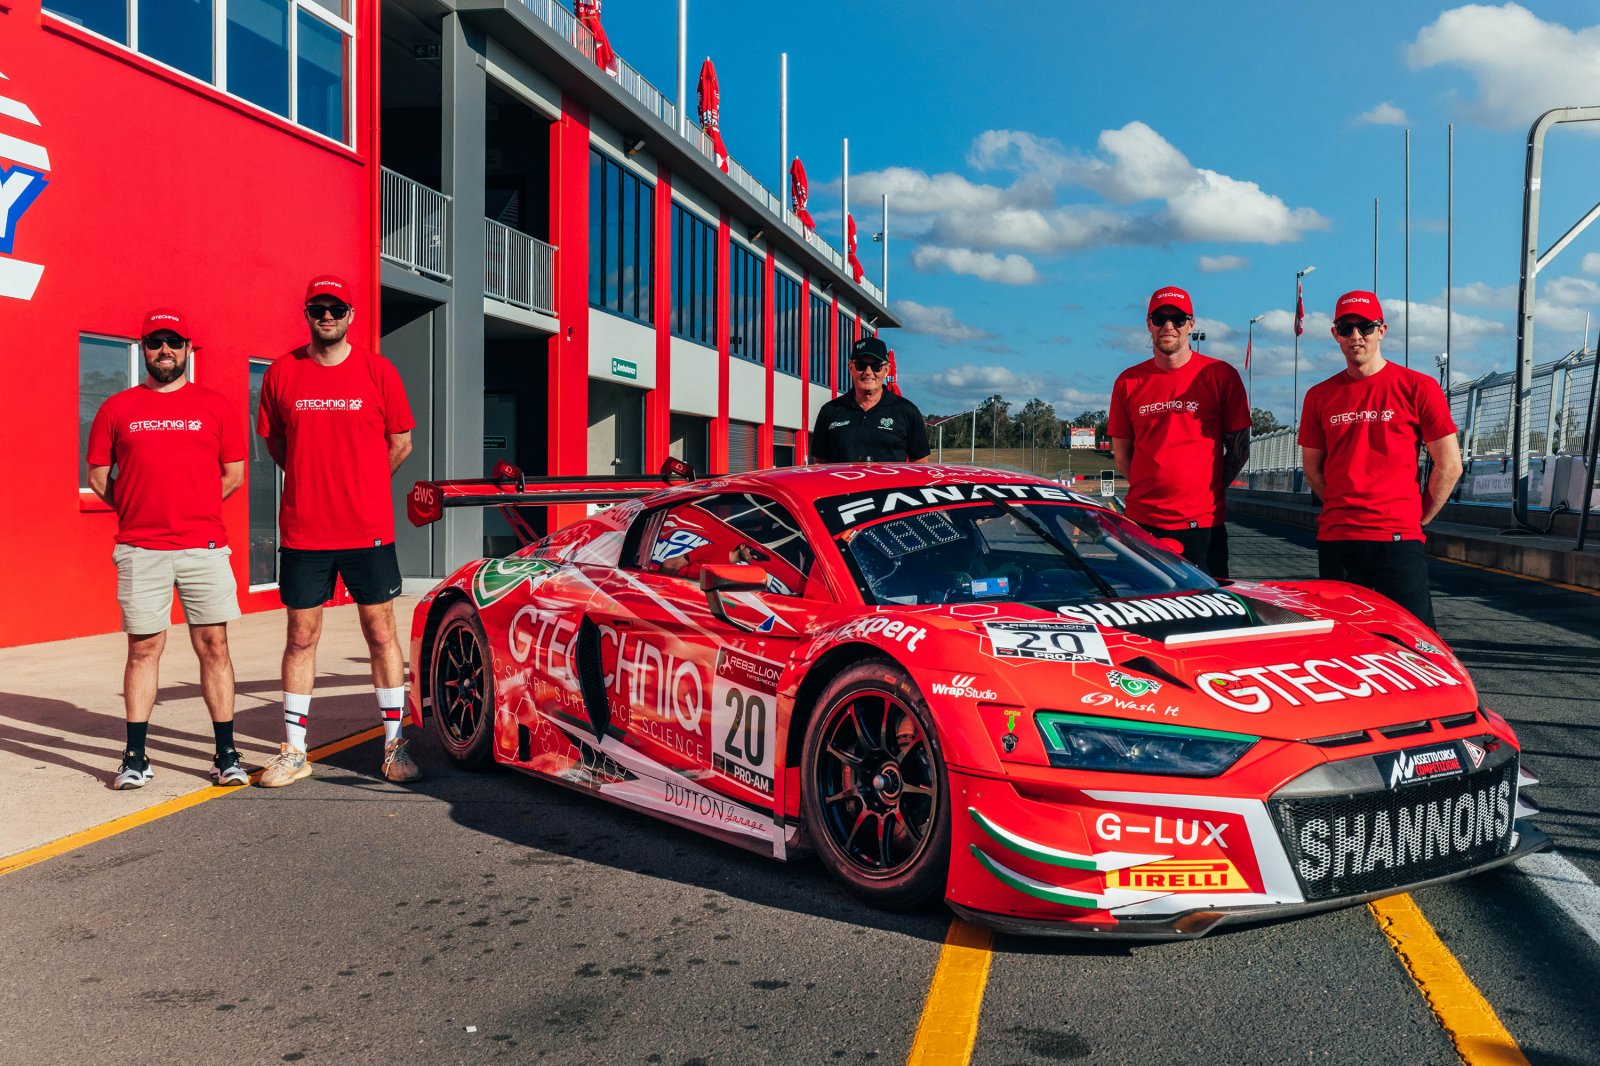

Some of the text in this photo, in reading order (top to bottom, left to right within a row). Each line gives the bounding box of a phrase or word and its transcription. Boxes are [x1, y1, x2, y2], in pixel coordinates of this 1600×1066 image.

[295, 399, 346, 408] GTECHNIQ
[1139, 400, 1183, 414] GTECHNIQ
[129, 419, 185, 430] GTECHNIQ
[1330, 410, 1378, 424] GTECHNIQ
[414, 485, 434, 505] aws
[837, 485, 1105, 526] FANATEC
[1057, 593, 1247, 627] SHANNONS
[1011, 631, 1085, 655] 20
[508, 604, 704, 737] GTECHNIQ
[729, 656, 781, 681] REBELLION
[1196, 650, 1463, 714] GTECHNIQ
[504, 665, 547, 697] SMART
[642, 716, 704, 763] SCIENCE
[1003, 709, 1021, 717] OPEN
[1115, 697, 1180, 717] Wash It
[725, 687, 766, 767] 20
[1413, 749, 1457, 765] ASSETTO CORSA
[734, 764, 769, 793] PRO-AM
[664, 781, 767, 832] DUTTON Garage
[1095, 812, 1230, 849] G-LUX
[1299, 780, 1510, 882] SHANNONS
[1118, 862, 1230, 887] PIRELLI
